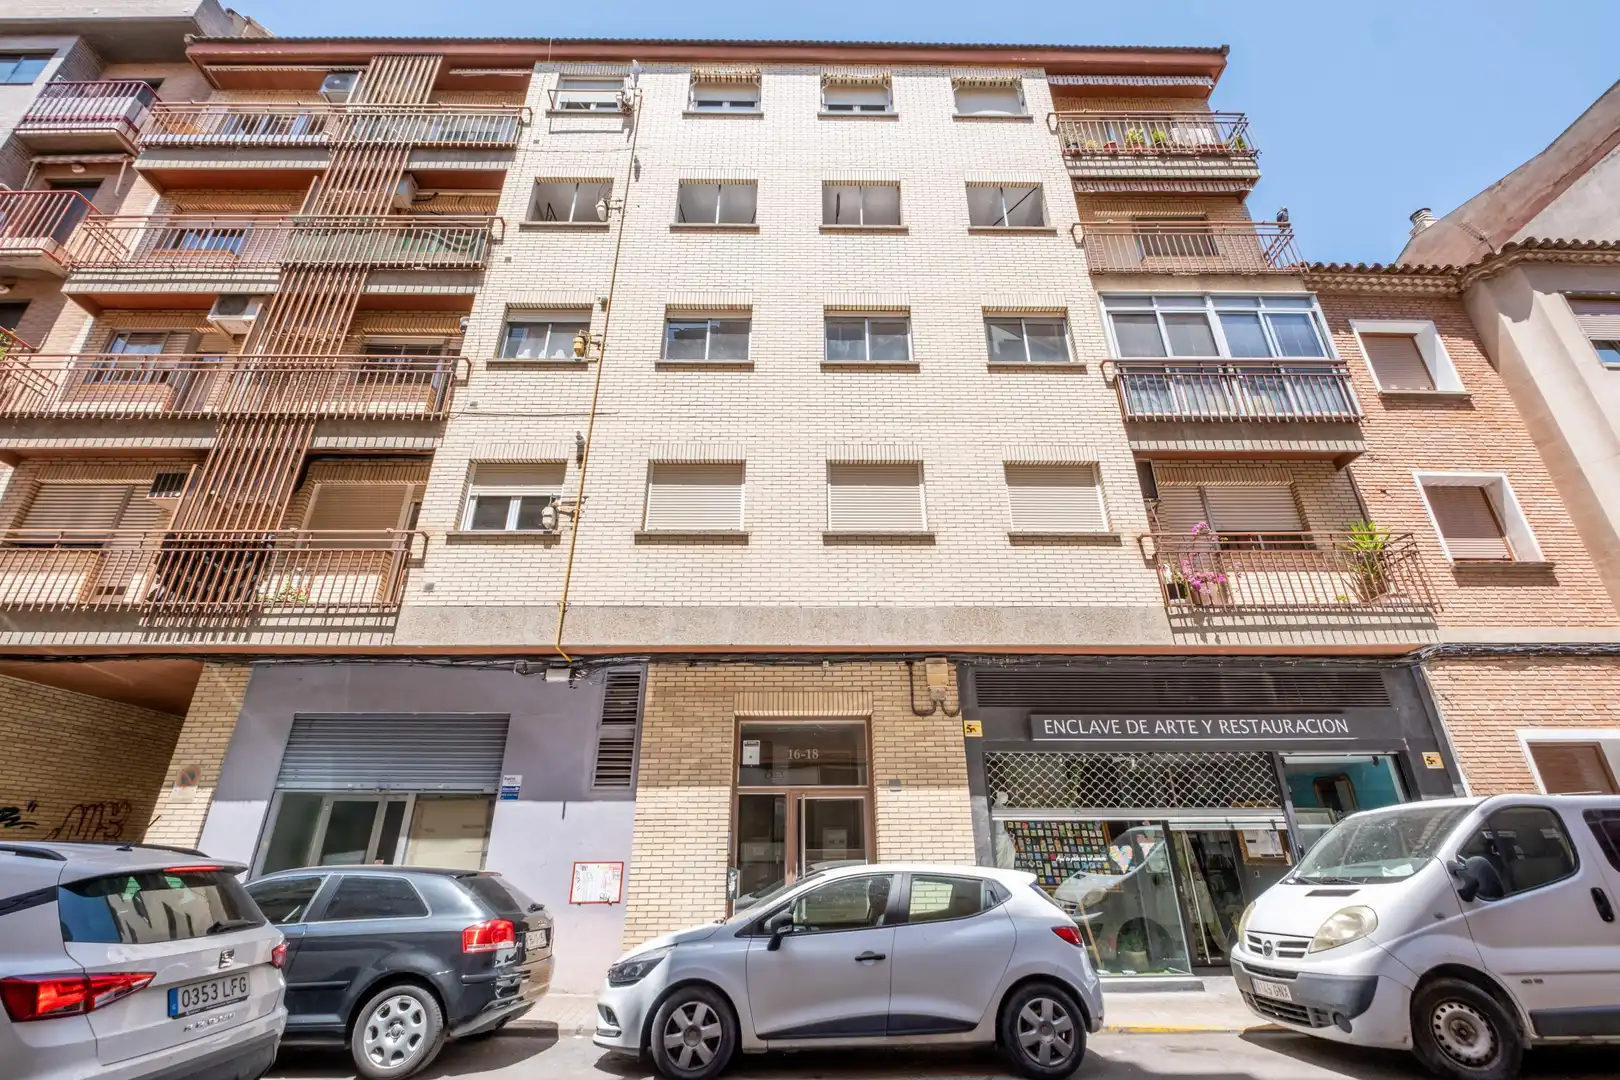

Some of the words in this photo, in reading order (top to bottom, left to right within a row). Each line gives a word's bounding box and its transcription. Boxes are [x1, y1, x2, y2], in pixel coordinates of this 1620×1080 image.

[1043, 718, 1122, 735] ENCLAVE
[1125, 718, 1150, 735] DE
[1154, 718, 1199, 735] ARTE
[1201, 718, 1213, 735] Y
[1218, 718, 1349, 735] RESTAURACION
[787, 748, 820, 760] 16-18
[181, 983, 219, 1008] 0353
[222, 977, 247, 998] LFG
